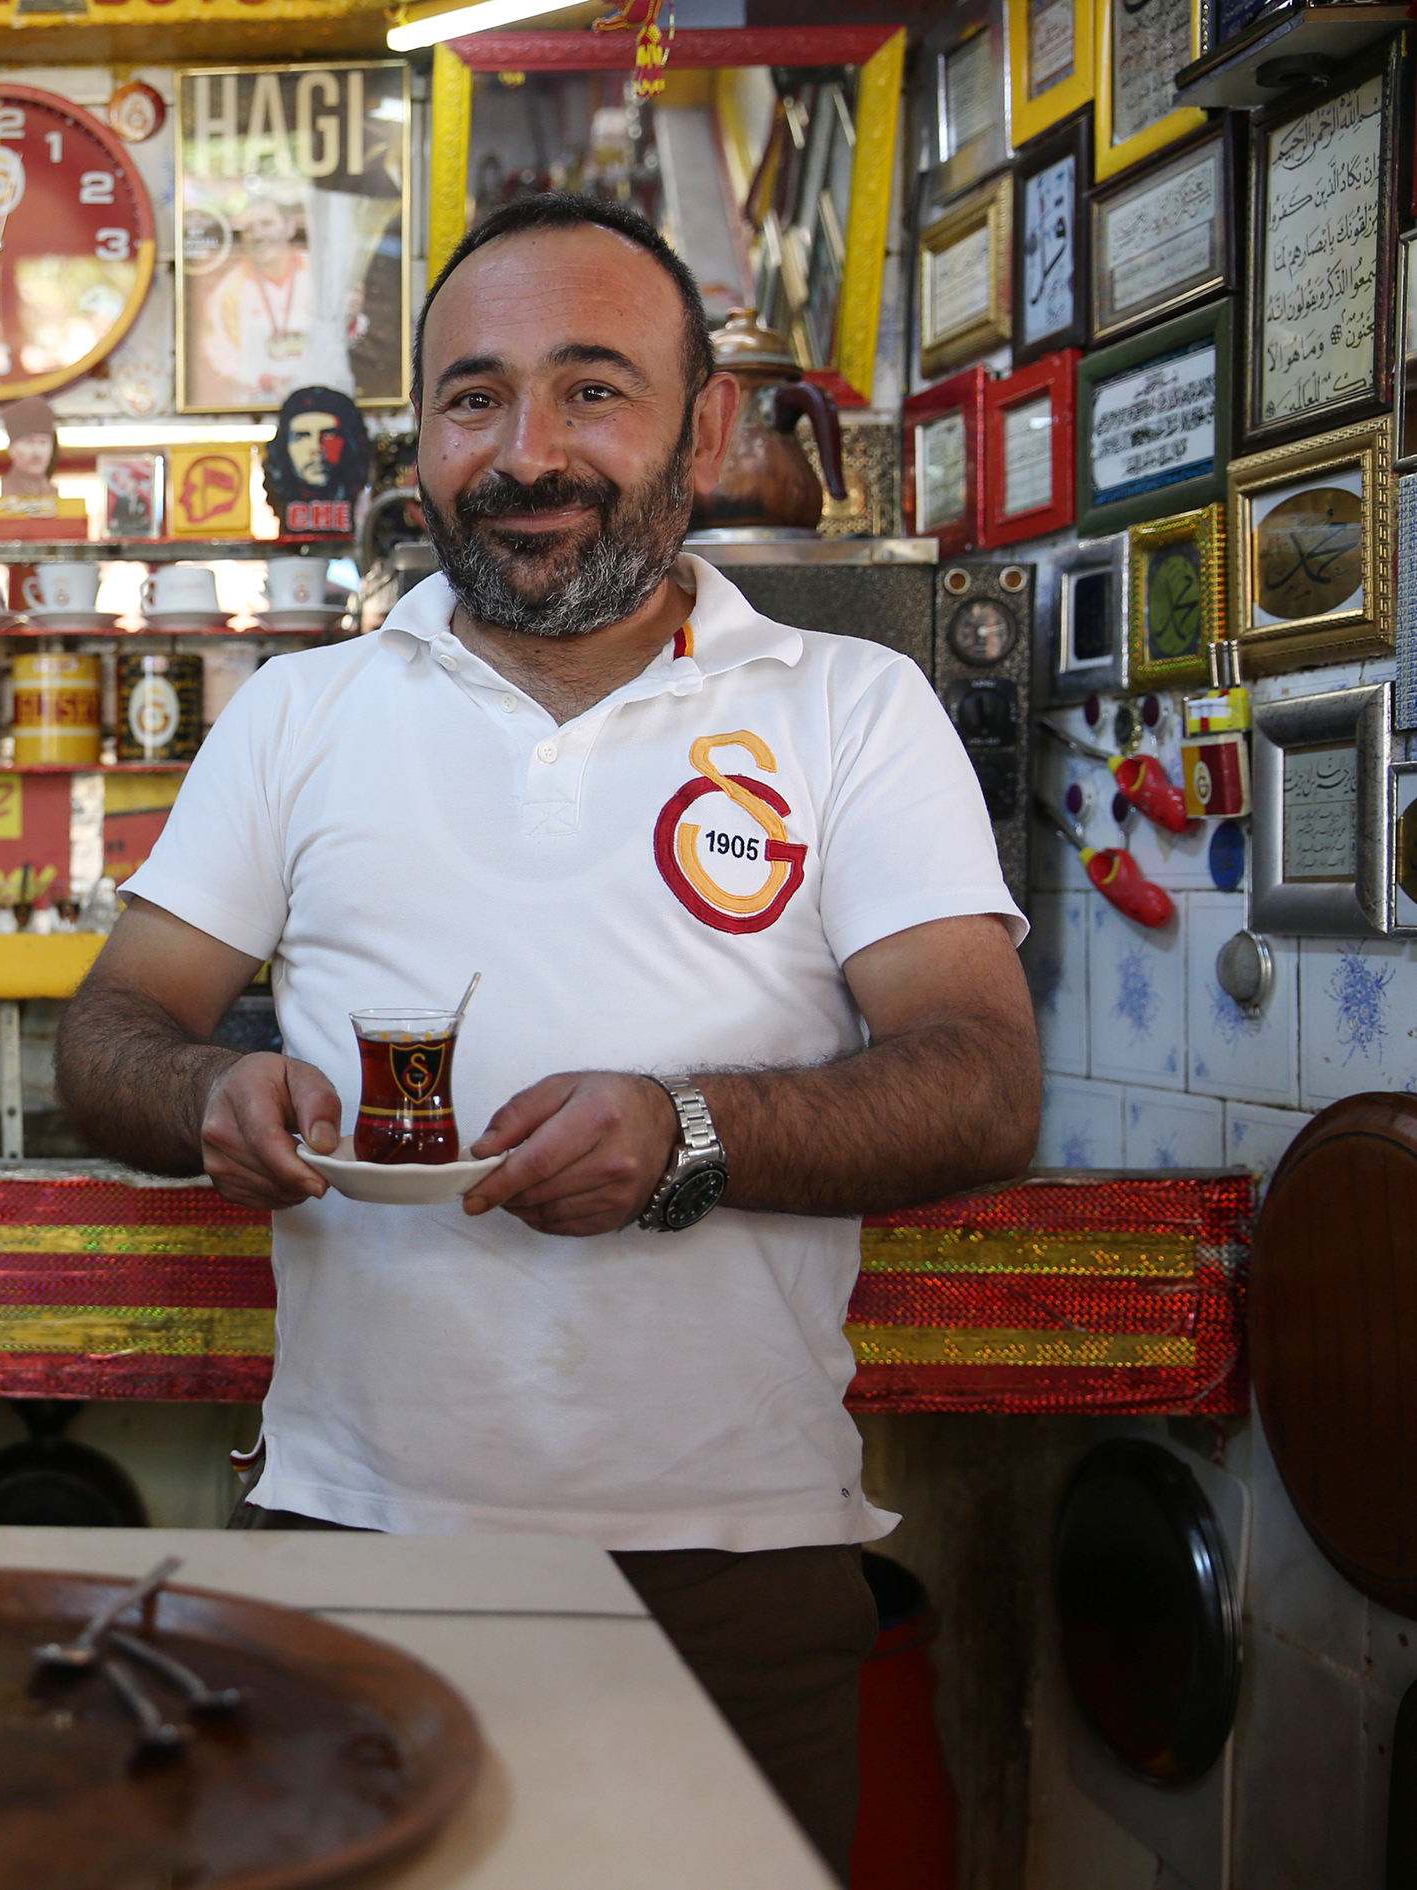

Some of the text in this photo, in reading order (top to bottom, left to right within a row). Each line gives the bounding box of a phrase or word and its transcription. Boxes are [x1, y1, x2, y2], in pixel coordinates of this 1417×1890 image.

[194, 70, 365, 178] HAGI
[45, 131, 63, 164] 1
[79, 171, 115, 204] 2
[95, 227, 130, 262] 3
[286, 501, 353, 532] CHE
[704, 829, 760, 862] 1905
